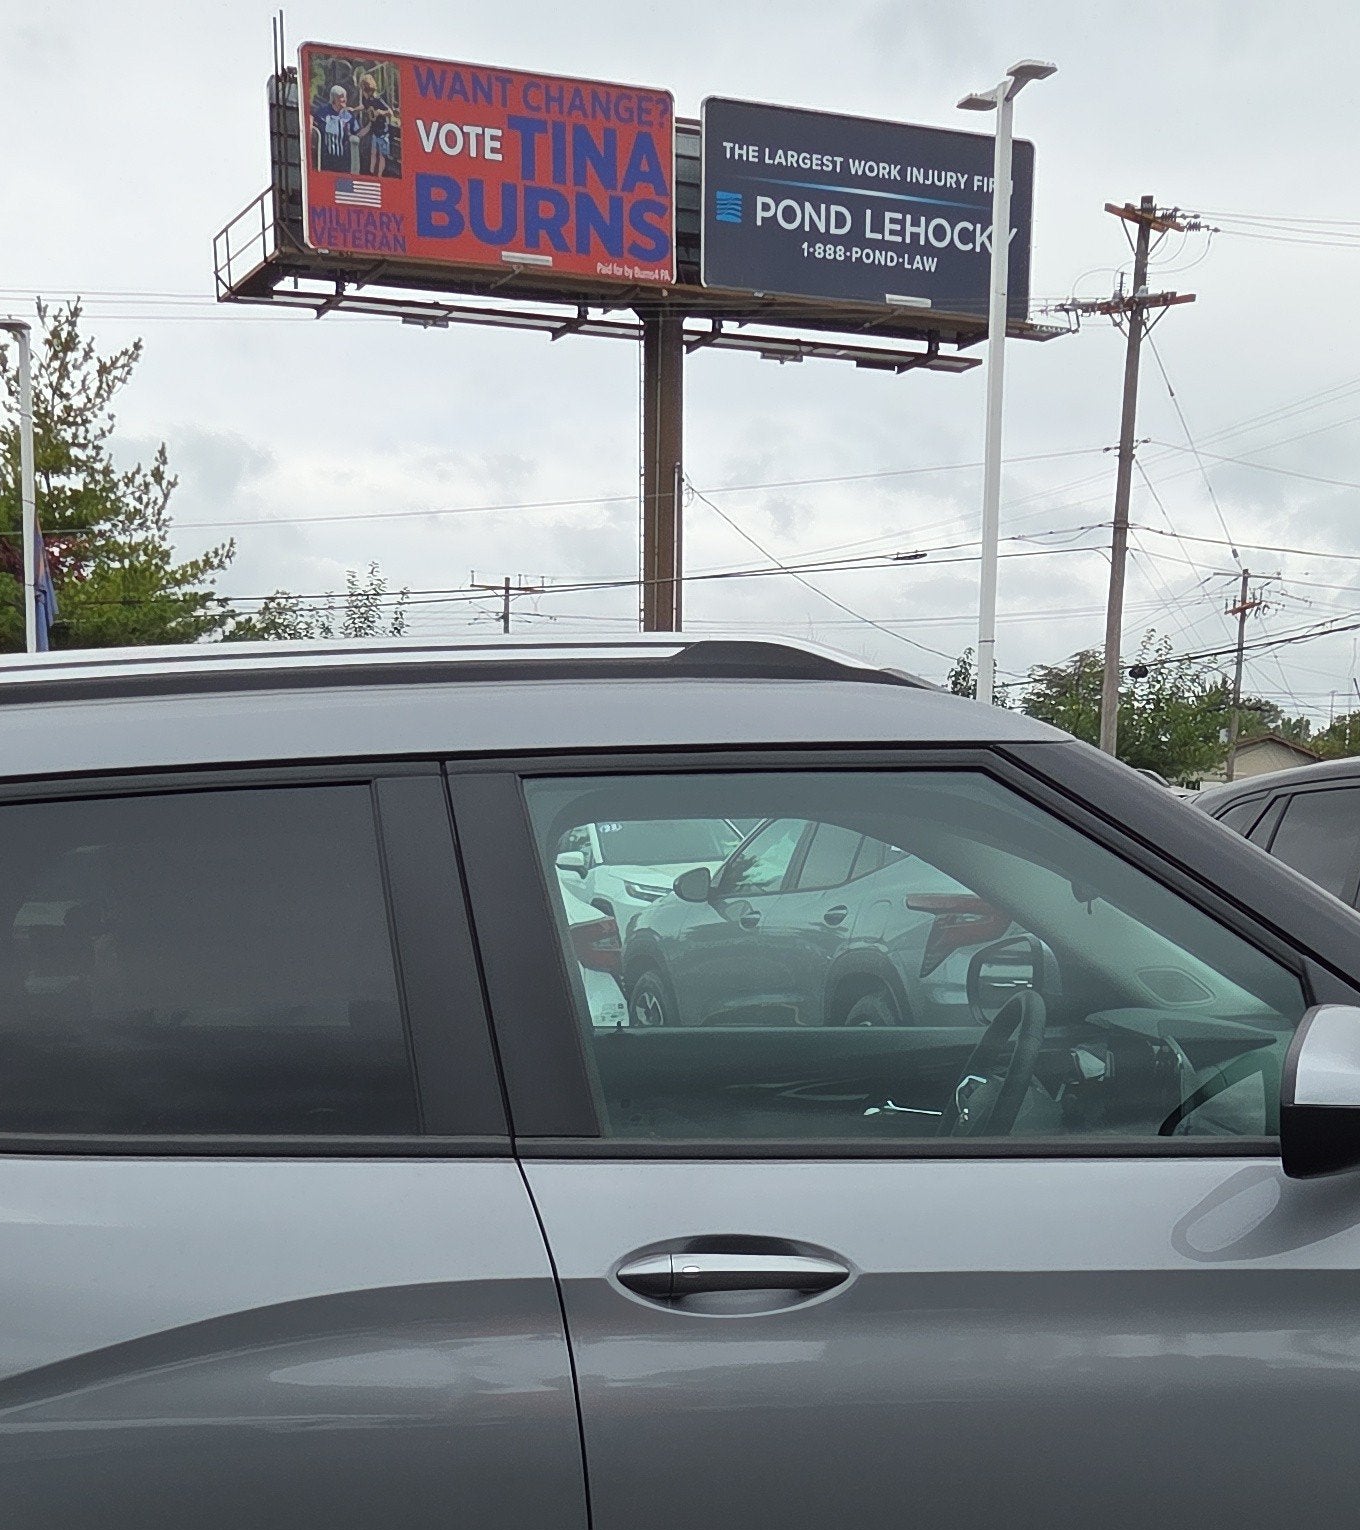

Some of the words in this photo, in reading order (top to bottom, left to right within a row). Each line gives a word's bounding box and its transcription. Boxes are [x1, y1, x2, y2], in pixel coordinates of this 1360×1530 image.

[414, 65, 513, 109] WANT
[522, 80, 669, 129] CHANGE?
[416, 119, 503, 162] VOTE
[507, 113, 670, 197] TINA
[722, 141, 759, 164] THE
[764, 147, 844, 174] LARGEST
[849, 158, 902, 182] WORK
[906, 166, 968, 191] INJURY
[311, 206, 406, 232] MILITARY
[313, 226, 407, 254] VETERAN
[415, 171, 671, 263] BURNS
[756, 195, 852, 236] POND
